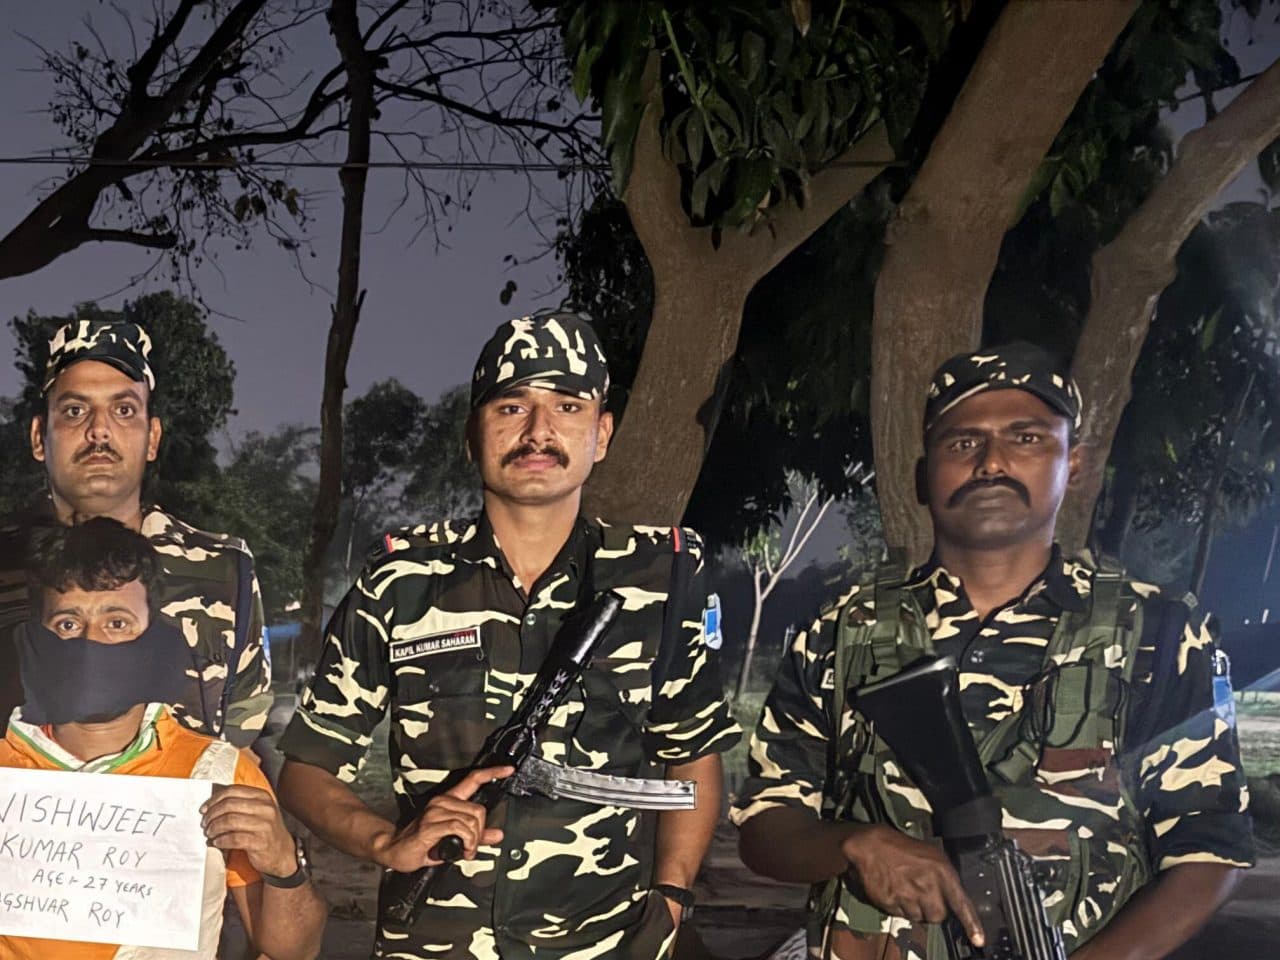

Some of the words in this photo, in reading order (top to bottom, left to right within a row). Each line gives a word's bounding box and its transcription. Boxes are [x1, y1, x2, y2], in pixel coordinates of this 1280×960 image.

[416, 641, 440, 653] KUMAR
[0, 832, 83, 869] KUMAR
[102, 846, 147, 868] ROY
[83, 876, 108, 890] 27
[115, 880, 153, 899] YEARS
[88, 901, 126, 928] ROY
